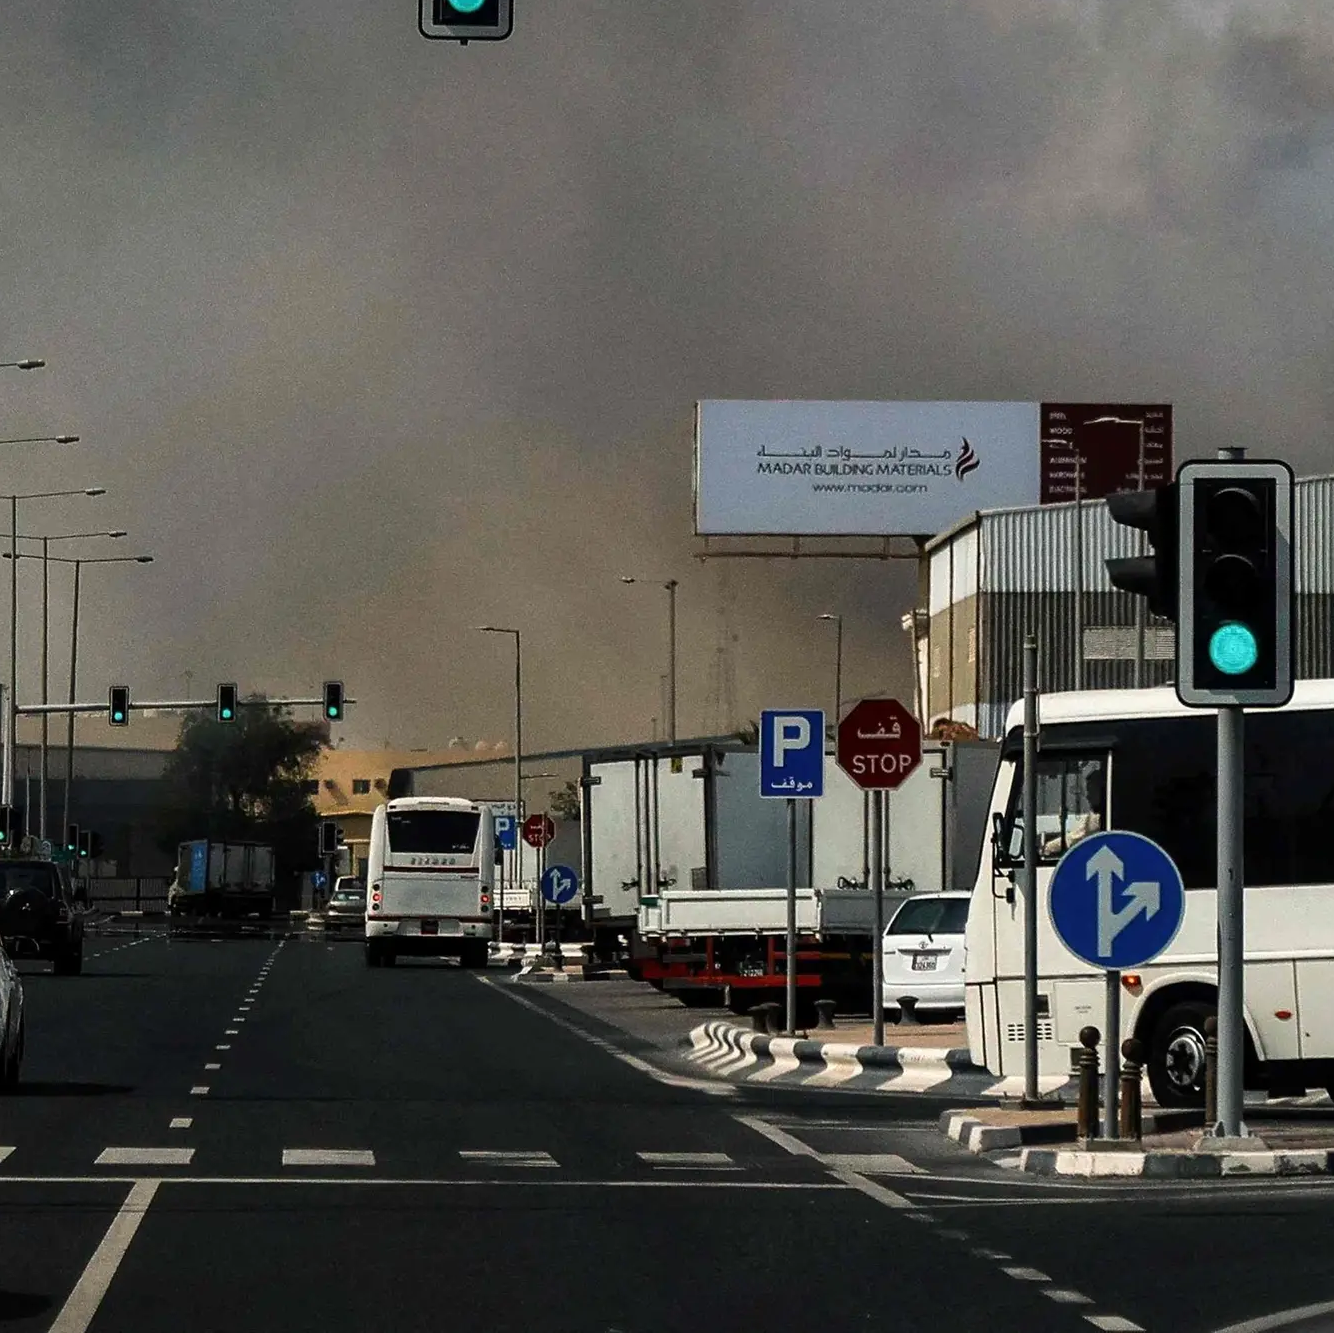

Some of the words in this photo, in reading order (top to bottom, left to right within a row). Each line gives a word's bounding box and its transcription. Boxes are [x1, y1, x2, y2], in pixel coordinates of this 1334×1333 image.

[757, 463, 811, 475] MADAR
[814, 463, 873, 475] BUILDING
[875, 463, 952, 475] MATERIALS
[857, 716, 901, 739] قف
[773, 716, 810, 767] P
[852, 754, 911, 774] STOP
[771, 777, 813, 792] موقف
